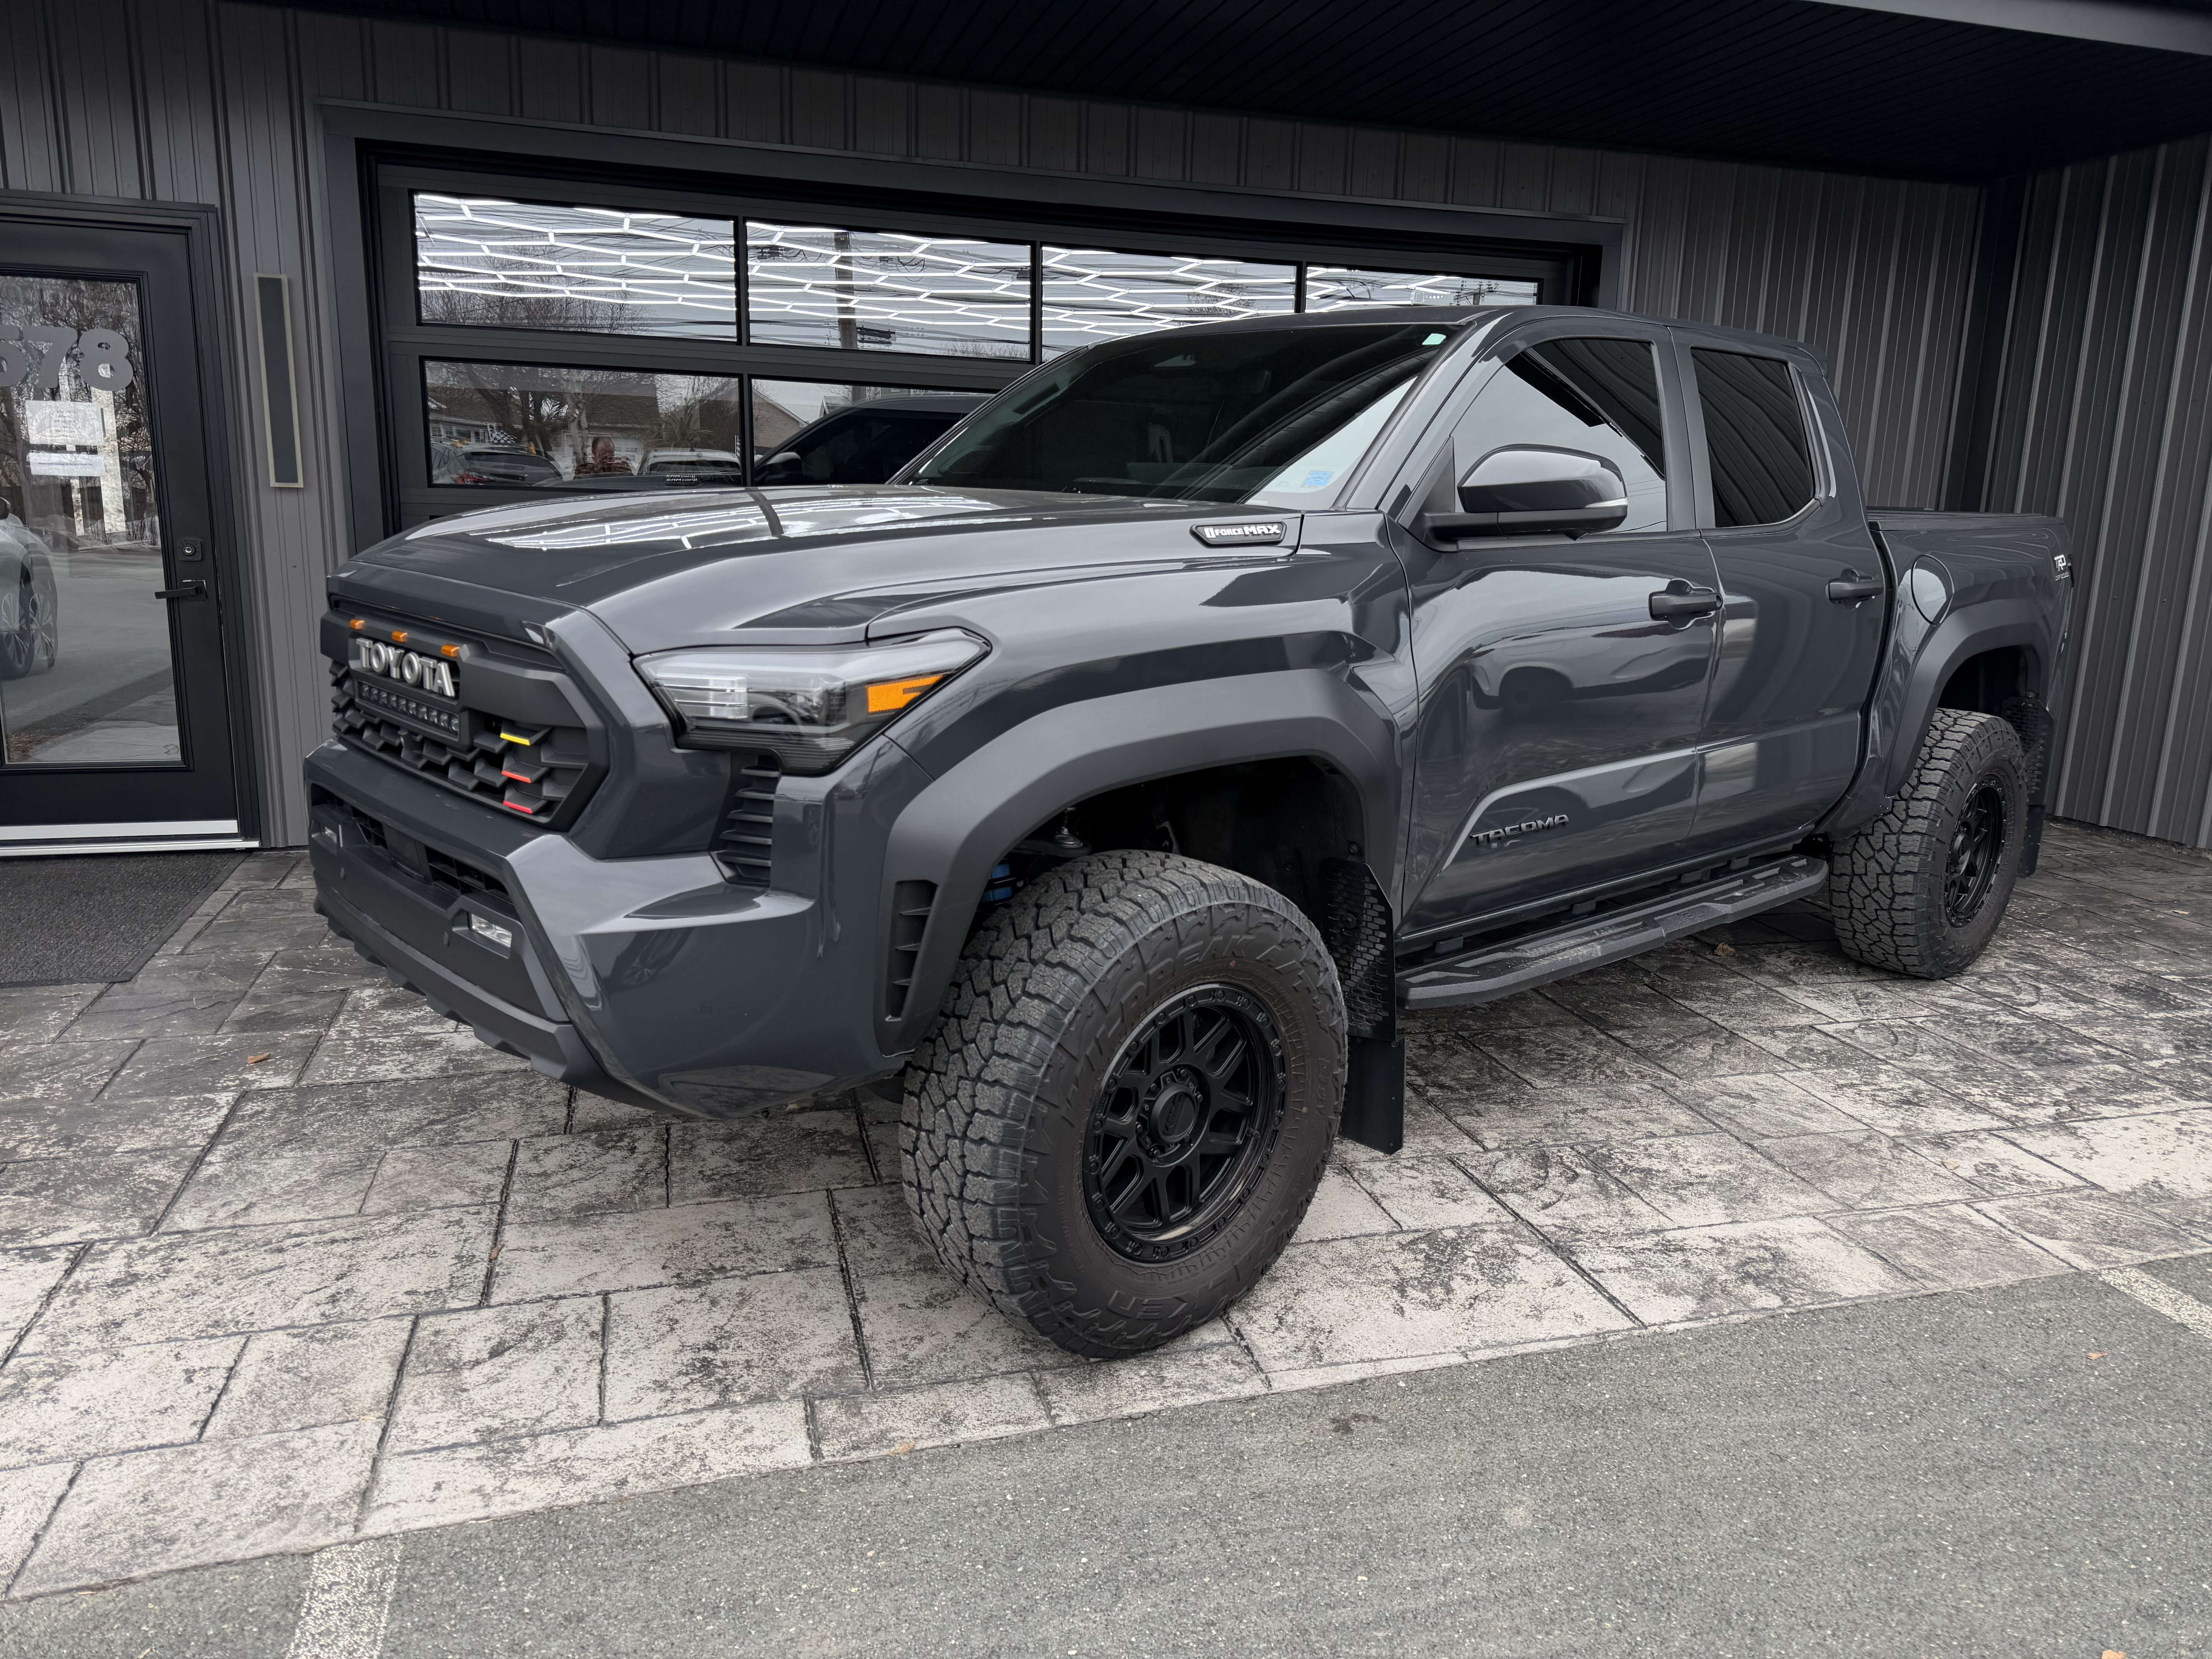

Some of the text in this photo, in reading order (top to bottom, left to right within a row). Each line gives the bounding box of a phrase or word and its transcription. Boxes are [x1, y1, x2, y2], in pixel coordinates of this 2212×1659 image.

[1243, 525, 1281, 534] MAX
[356, 638, 455, 697] TOYOTA
[1470, 814, 1569, 845] TACOMA
[1058, 935, 1255, 1127] WILDPEAK
